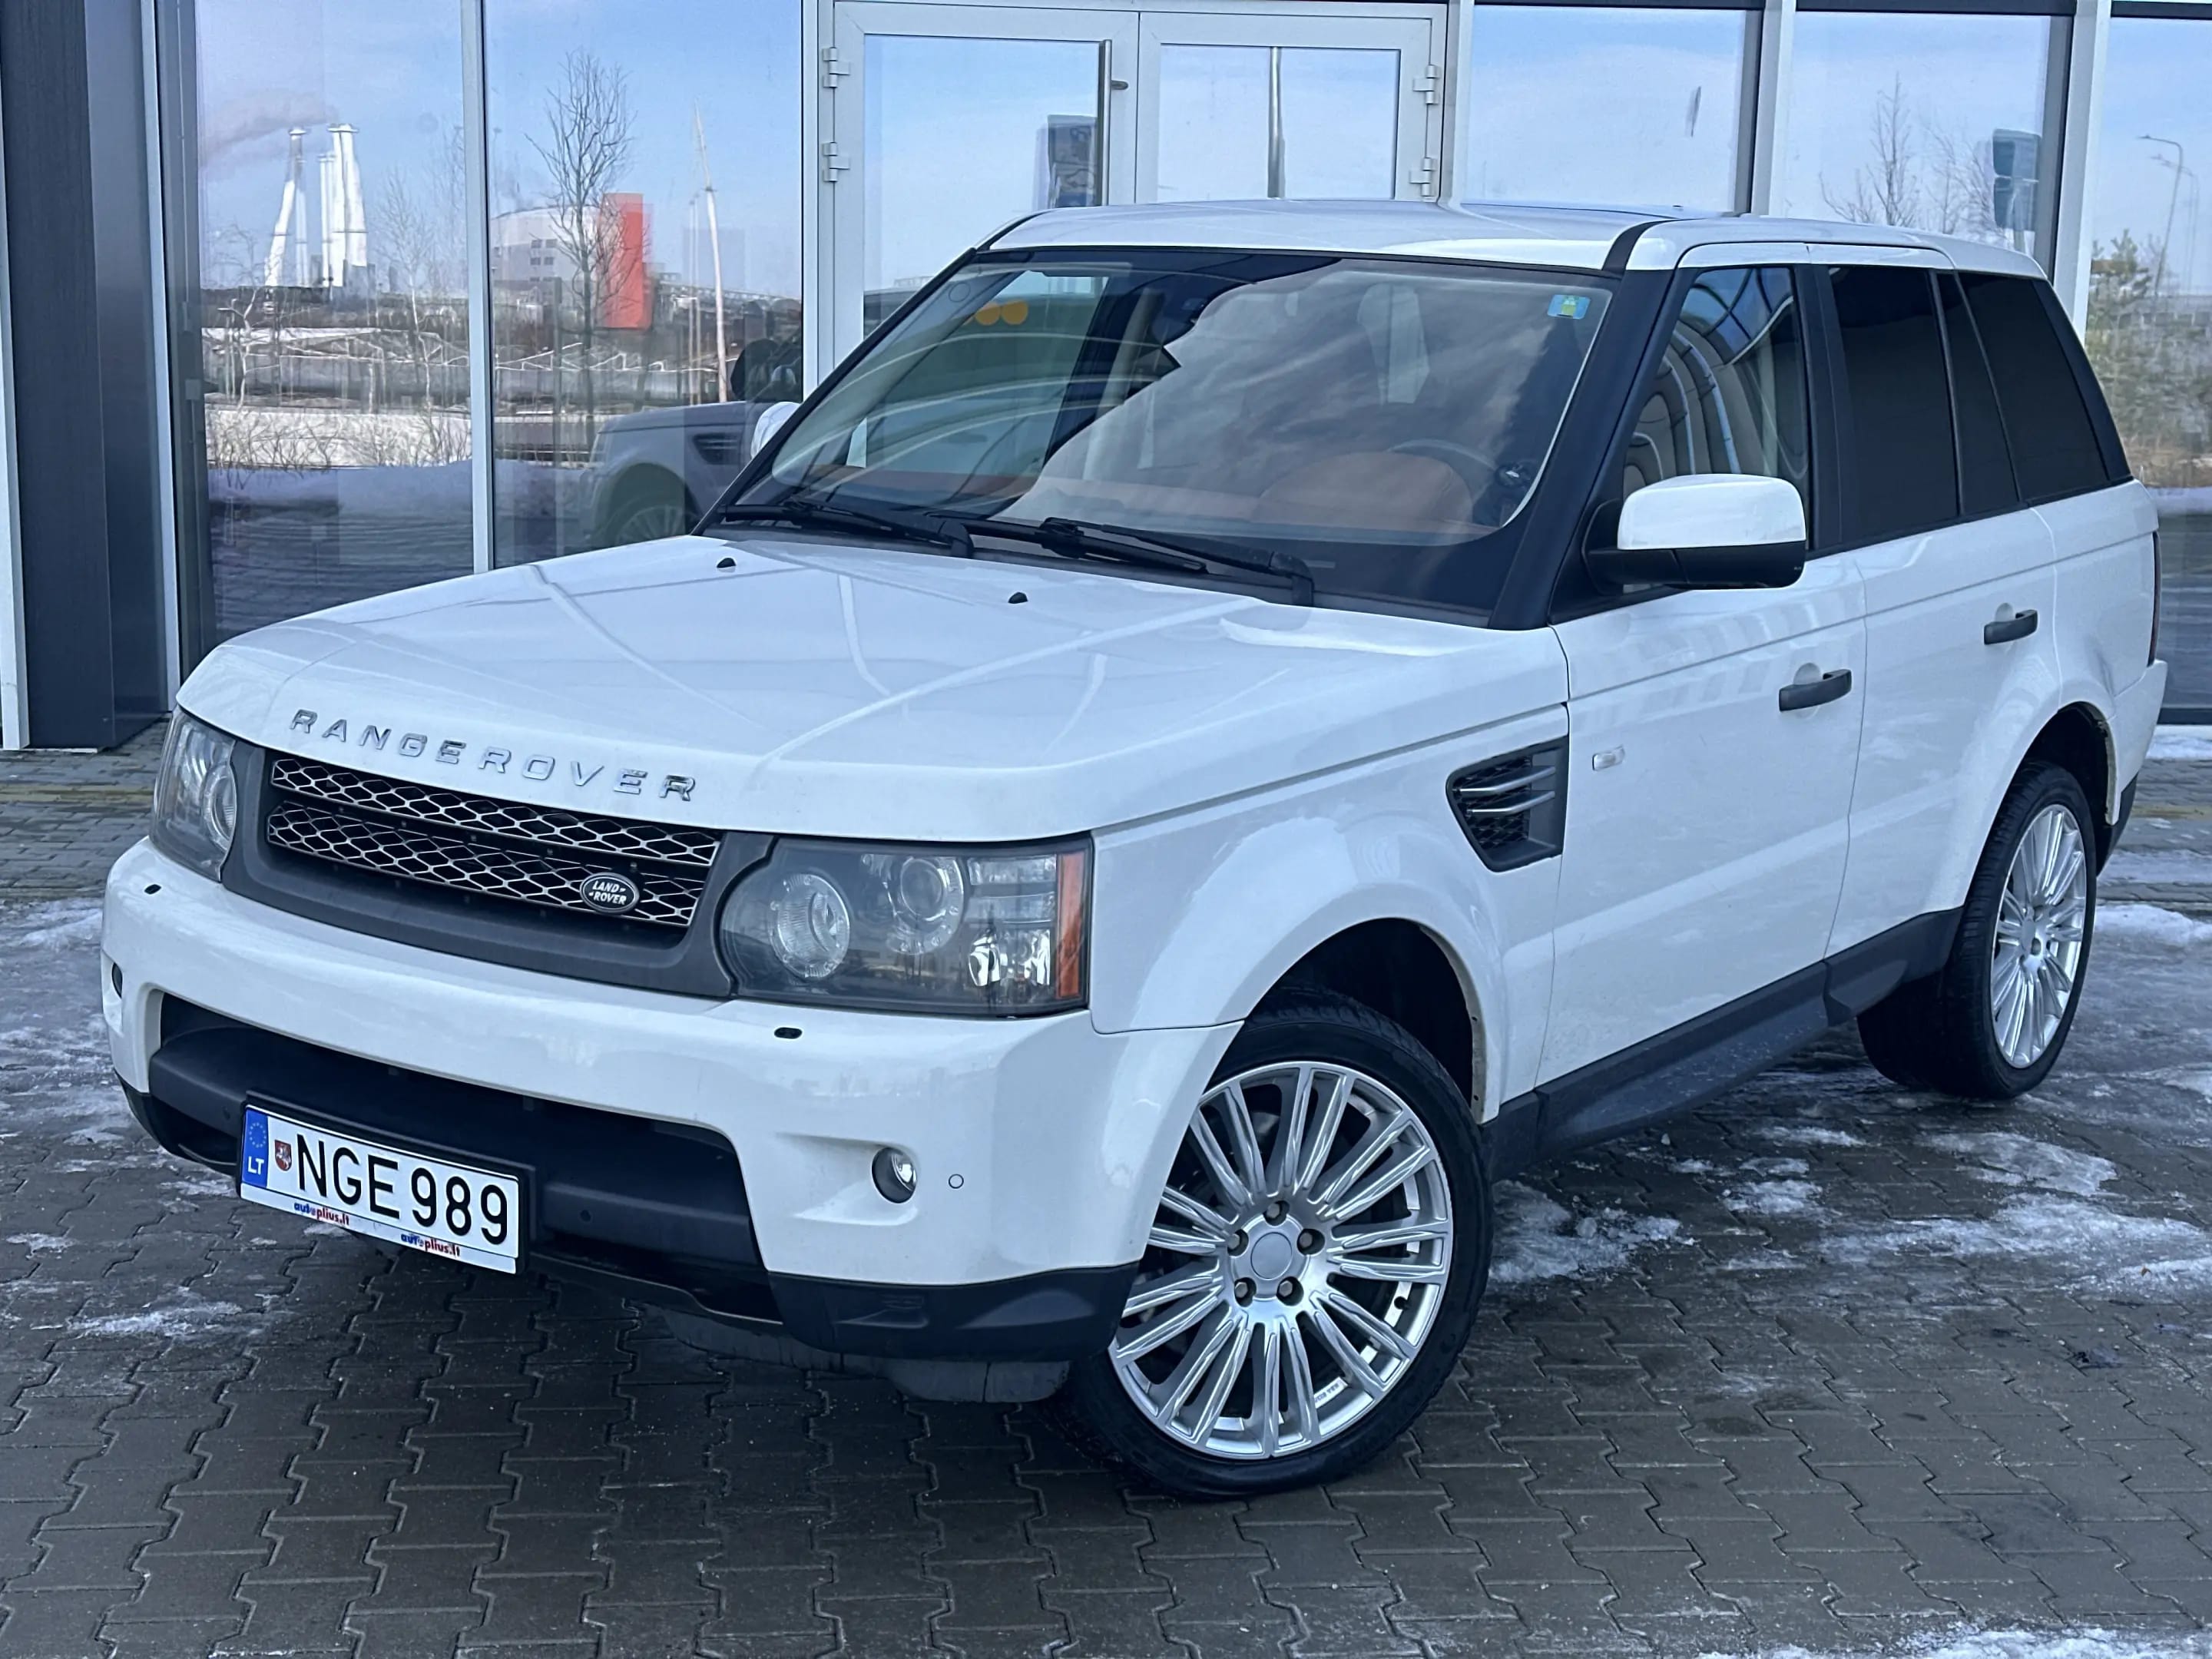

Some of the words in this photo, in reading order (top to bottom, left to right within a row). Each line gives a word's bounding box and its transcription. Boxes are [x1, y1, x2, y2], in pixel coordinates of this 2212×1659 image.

[290, 709, 467, 765] RANGE
[478, 747, 697, 802] ROVER
[592, 880, 620, 893] LAND
[593, 891, 627, 905] ROVER
[247, 1156, 266, 1176] LT
